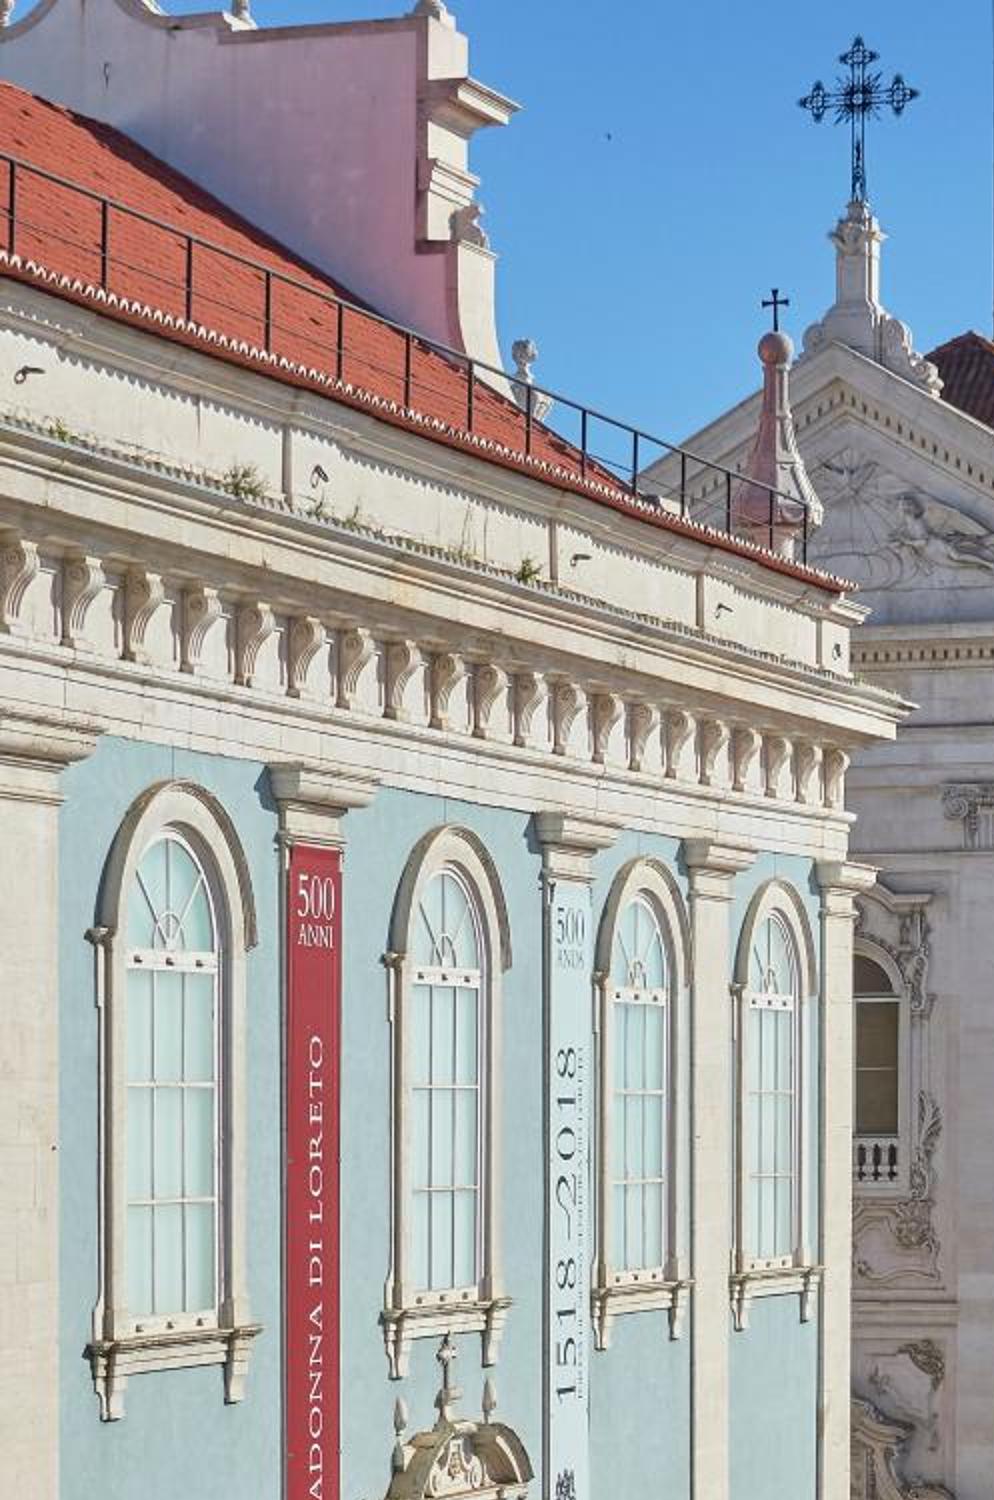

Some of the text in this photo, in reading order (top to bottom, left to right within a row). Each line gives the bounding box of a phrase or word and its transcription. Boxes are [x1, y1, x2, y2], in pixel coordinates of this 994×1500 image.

[297, 874, 335, 920] 500
[297, 923, 334, 948] ANNI
[557, 907, 585, 946] 500
[309, 1035, 324, 1224] LORETO
[309, 1241, 324, 1287] DI
